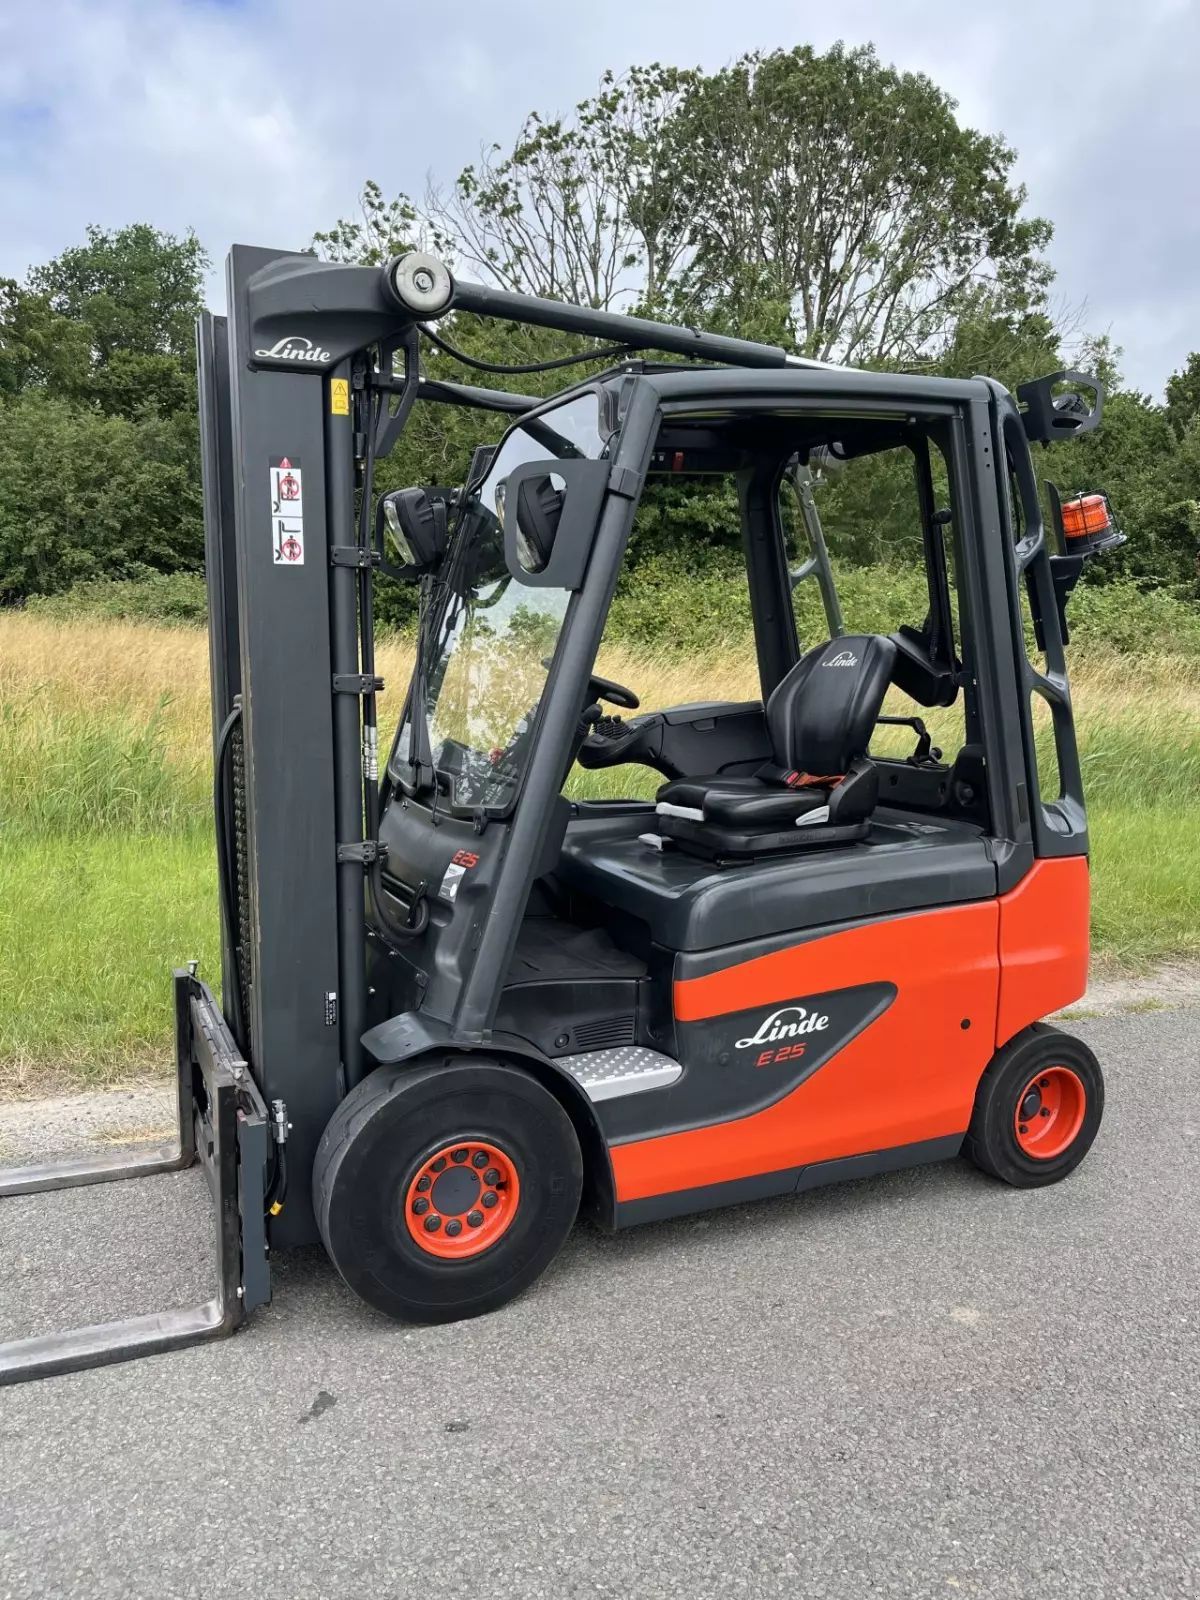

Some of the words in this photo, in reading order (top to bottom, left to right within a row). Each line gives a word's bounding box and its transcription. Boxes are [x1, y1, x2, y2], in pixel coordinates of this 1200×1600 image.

[254, 336, 331, 363] Linde
[821, 650, 858, 667] Linde
[734, 1006, 830, 1049] Linde
